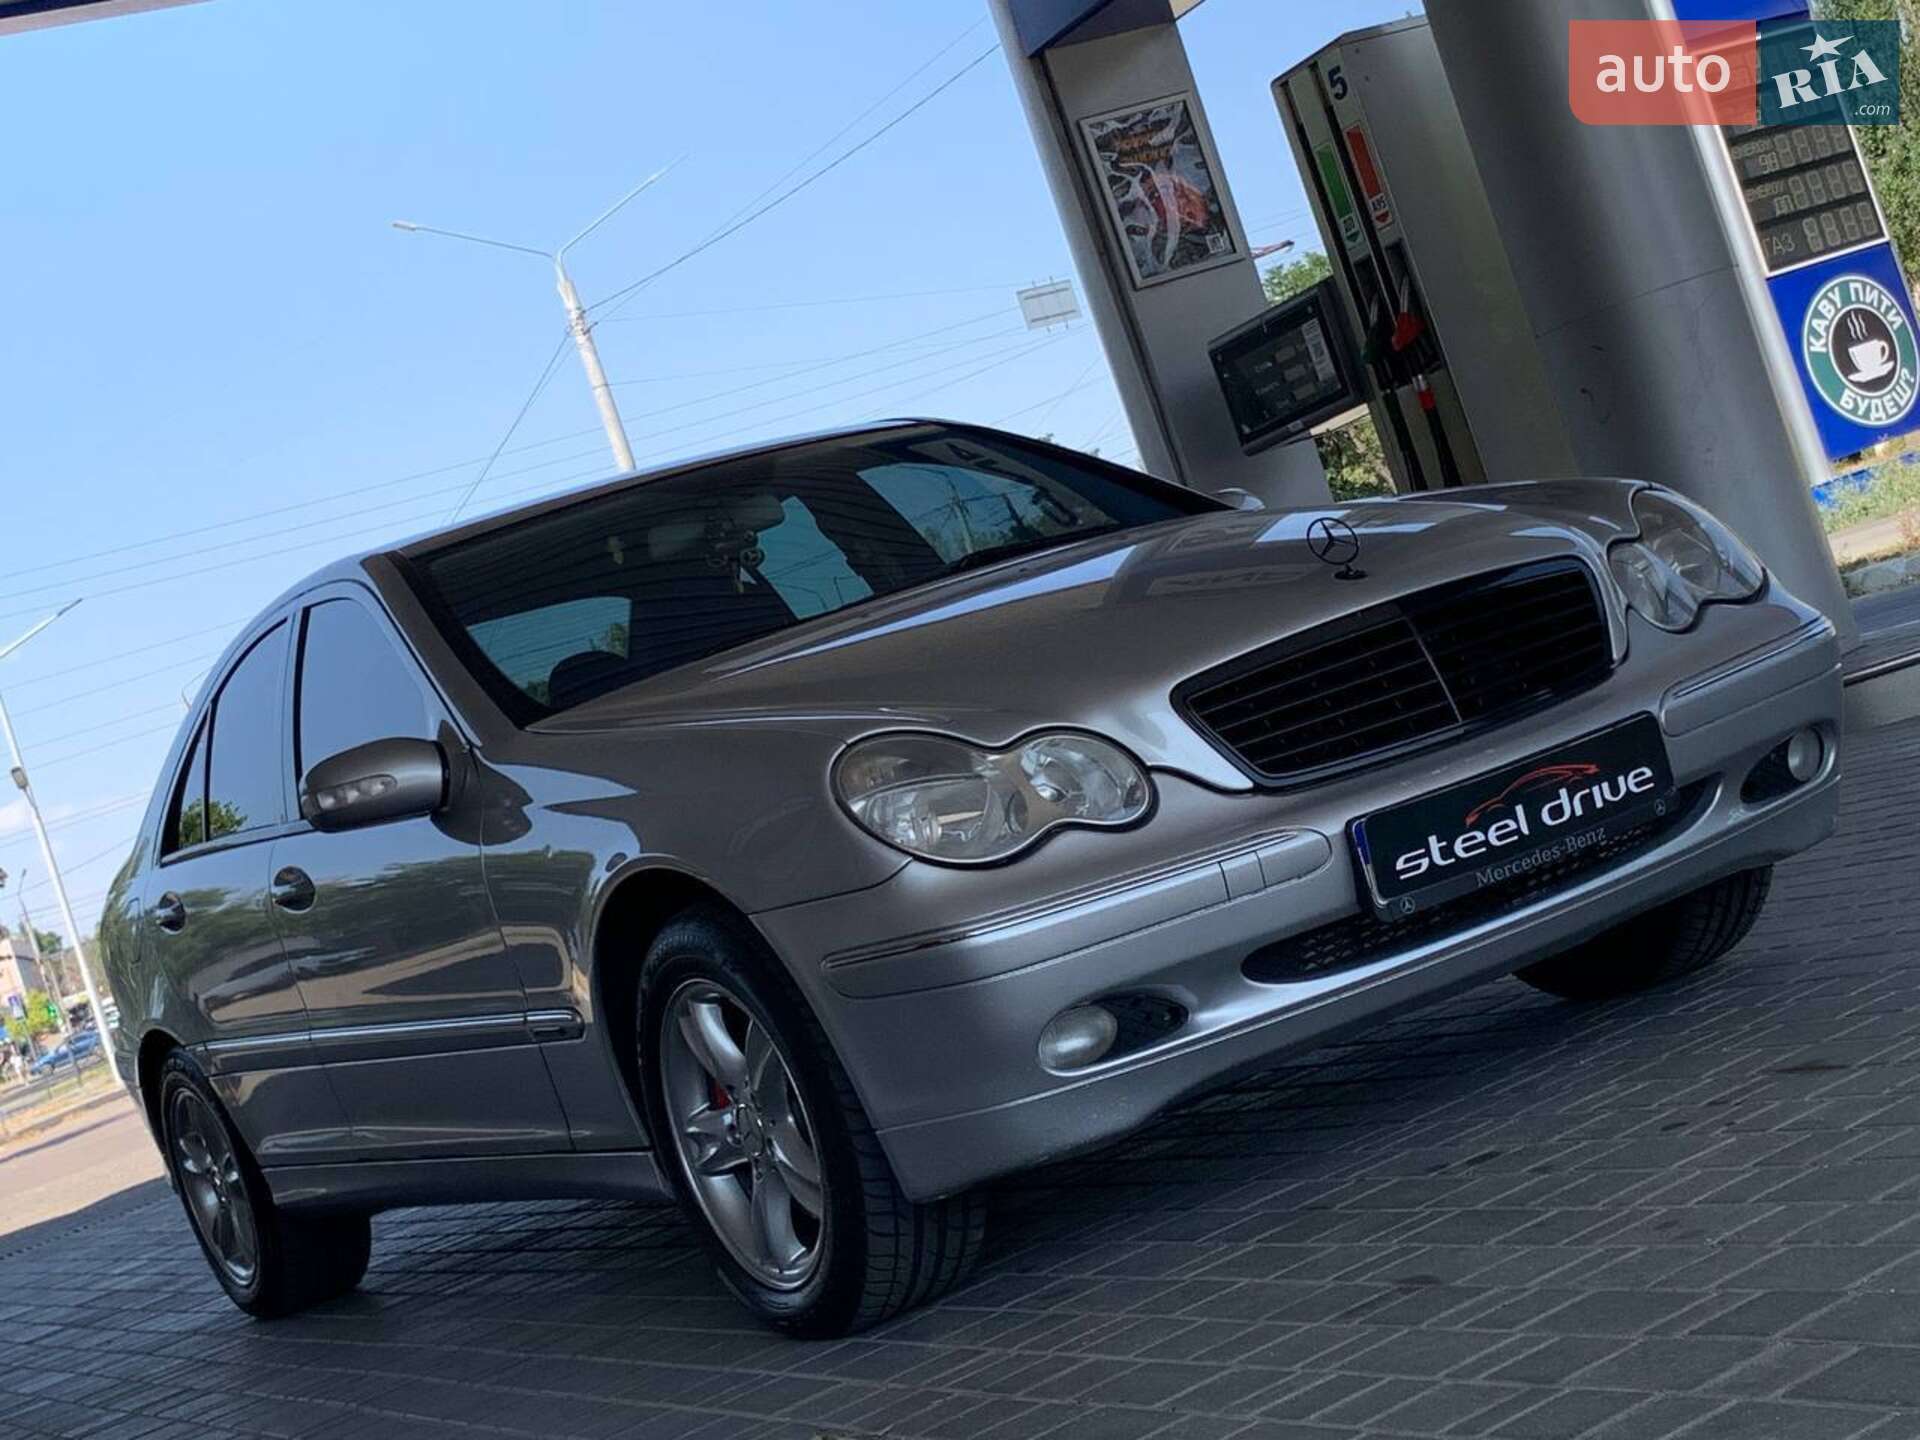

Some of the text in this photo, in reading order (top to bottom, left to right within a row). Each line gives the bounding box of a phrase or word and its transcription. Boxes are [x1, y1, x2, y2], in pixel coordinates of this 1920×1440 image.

[1328, 65, 1348, 100] 5
[1809, 282, 1904, 353] КАВУ ПИТИ
[1839, 367, 1915, 422] БУДЕШ?
[1395, 766, 1655, 880] steel drive
[1475, 826, 1607, 888] Mercedes-Benz
